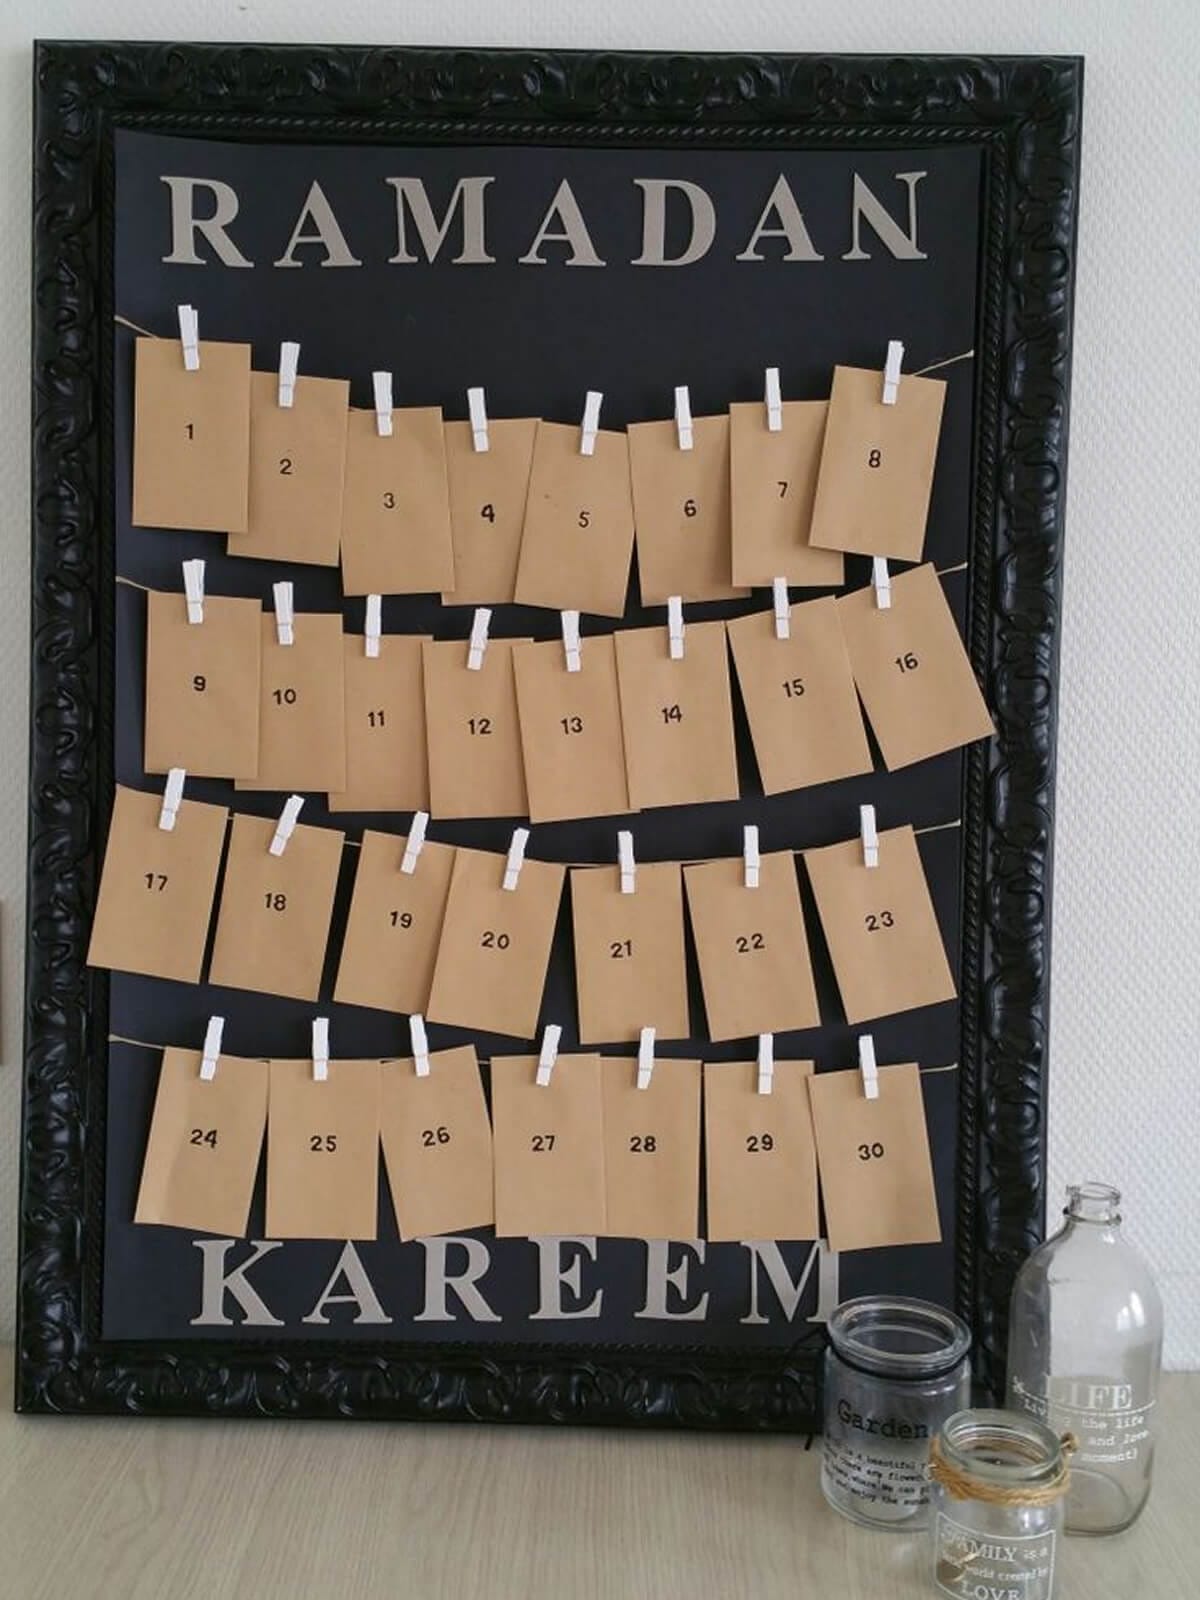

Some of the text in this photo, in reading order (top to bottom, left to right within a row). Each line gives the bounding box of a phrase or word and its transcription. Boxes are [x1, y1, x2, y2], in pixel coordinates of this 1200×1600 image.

[160, 171, 928, 269] RAMADAN
[185, 423, 194, 441] 1
[279, 458, 293, 476] 2
[868, 449, 882, 469] 8
[777, 481, 789, 499] 7
[383, 492, 396, 510] 3
[683, 499, 697, 518] 6
[480, 503, 496, 524] 4
[578, 510, 591, 529] 5
[894, 651, 919, 674] 16
[192, 675, 207, 692] 9
[782, 678, 805, 698] 15
[272, 688, 297, 706] 10
[367, 710, 385, 728] 11
[661, 704, 683, 725] 14
[467, 717, 492, 736] 12
[560, 715, 584, 735] 13
[144, 872, 169, 892] 17
[264, 892, 287, 912] 18
[389, 910, 413, 929] 19
[865, 911, 894, 931] 23
[481, 930, 510, 950] 20
[610, 939, 633, 959] 21
[736, 933, 764, 953] 22
[189, 1128, 218, 1149] 24
[309, 1134, 337, 1153] 25
[421, 1126, 451, 1148] 26
[531, 1134, 556, 1153] 27
[629, 1135, 657, 1153] 28
[746, 1133, 774, 1153] 29
[857, 1141, 885, 1161] 30
[190, 1237, 839, 1326] KAREEM
[1052, 1383, 1132, 1409] IFE
[838, 1399, 928, 1439] Garden
